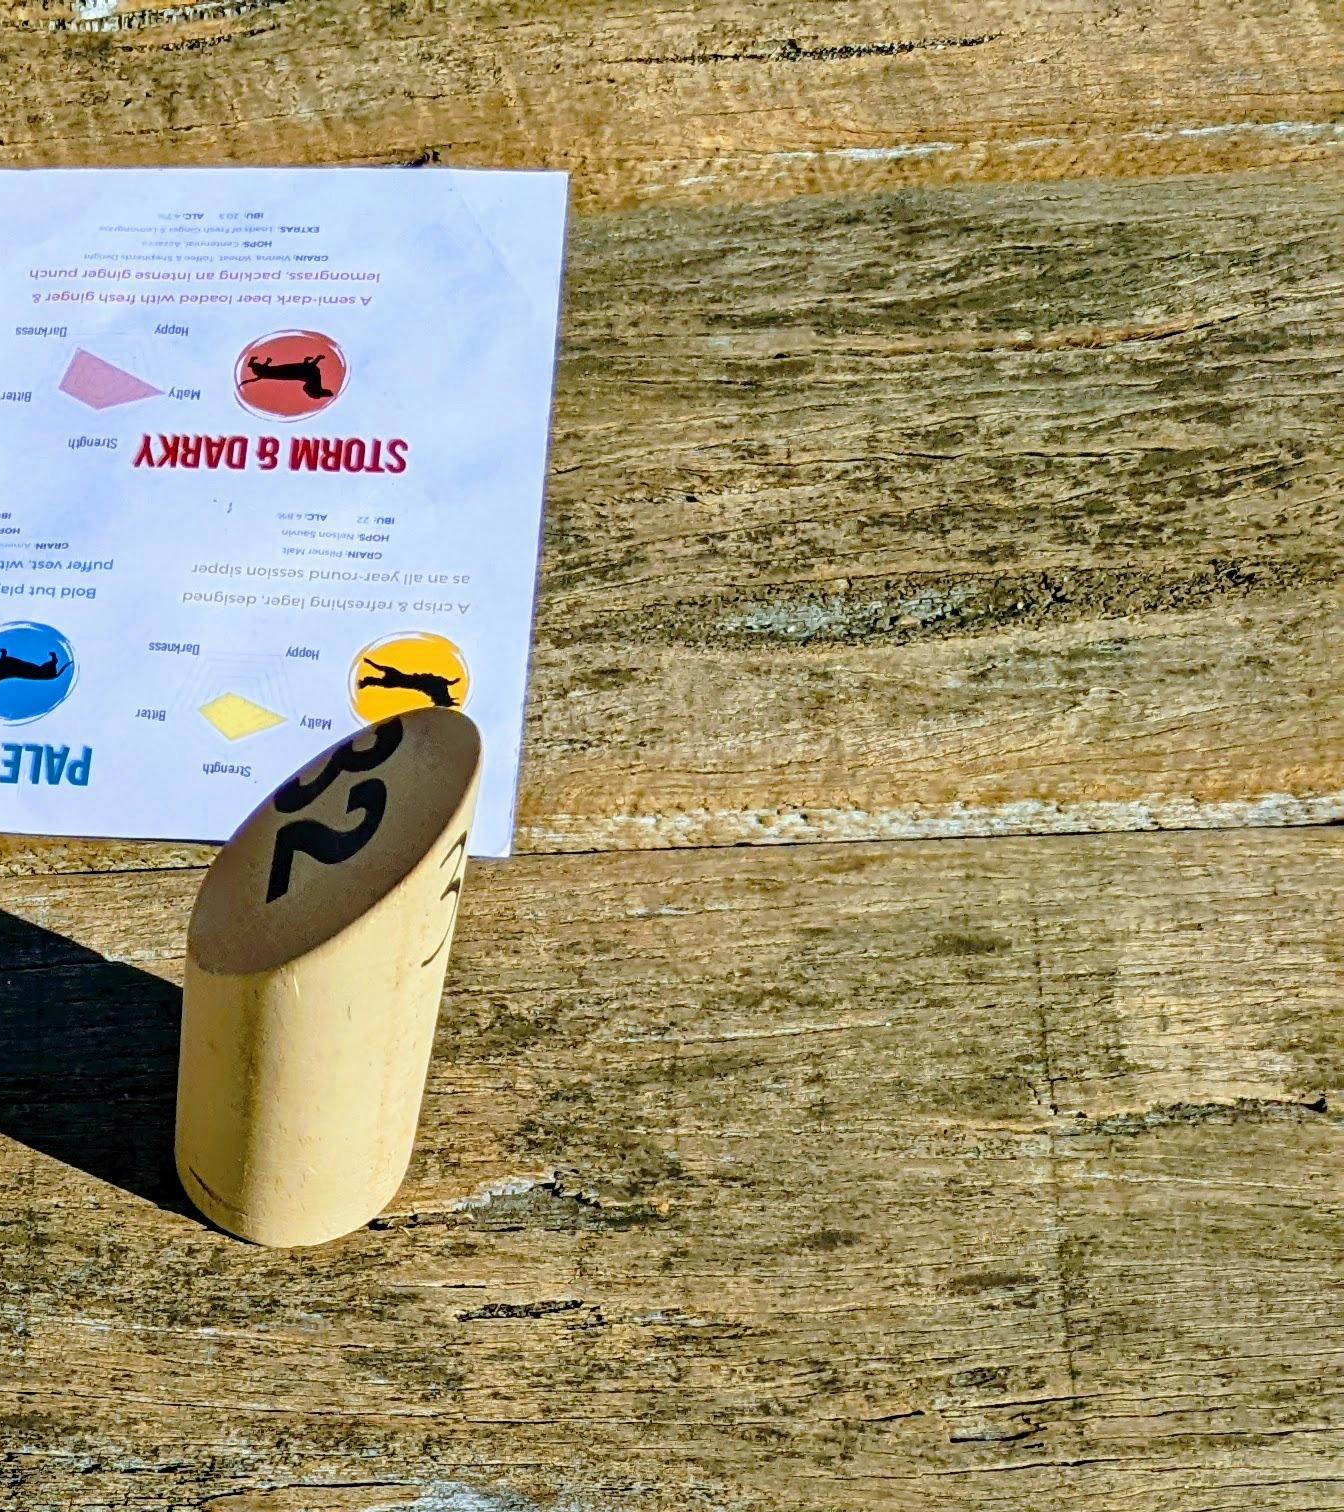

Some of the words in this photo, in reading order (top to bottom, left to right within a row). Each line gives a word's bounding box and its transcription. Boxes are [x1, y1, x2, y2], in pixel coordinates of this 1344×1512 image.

[28, 267, 78, 281] punch
[81, 267, 131, 281] ginger
[134, 271, 191, 282] intense
[195, 271, 215, 280] an
[219, 269, 281, 282] packing
[284, 268, 380, 283] lemongrass,
[31, 293, 41, 304] &
[44, 289, 94, 304] ginger
[98, 292, 136, 305] fresh
[140, 293, 175, 305] with
[178, 293, 232, 305] loaded
[236, 293, 272, 305] beer
[275, 294, 357, 307] semi-dark
[359, 295, 372, 306] A
[14, 325, 67, 338] Darkness
[152, 323, 189, 336] Hoppy
[0, 390, 32, 403] Bitter
[167, 387, 201, 401] Malty
[67, 435, 118, 450] Strength
[131, 433, 249, 471] DARKY
[254, 435, 281, 471] &
[287, 436, 409, 474] STORM
[317, 530, 355, 541] Nelson
[281, 546, 306, 557] Malt
[307, 547, 343, 558] Pilsner
[27, 558, 62, 571] vest,
[65, 557, 114, 573] puffer
[190, 561, 243, 579] sipper
[245, 565, 304, 580] session
[308, 568, 400, 584] year-round
[403, 572, 423, 586] all
[427, 573, 448, 585] an
[451, 573, 471, 586] as
[28, 584, 56, 599] but
[59, 585, 97, 599] Bold
[181, 589, 257, 607] designed
[260, 593, 305, 610] lager,
[309, 594, 393, 613] refreshing
[396, 600, 409, 613] &
[411, 598, 453, 615] crisp
[456, 601, 471, 614] A
[147, 641, 201, 656] Darkness
[284, 644, 320, 661] Hoppy
[134, 706, 167, 722] Bitter
[298, 714, 333, 730] Malty
[201, 760, 252, 778] Strength
